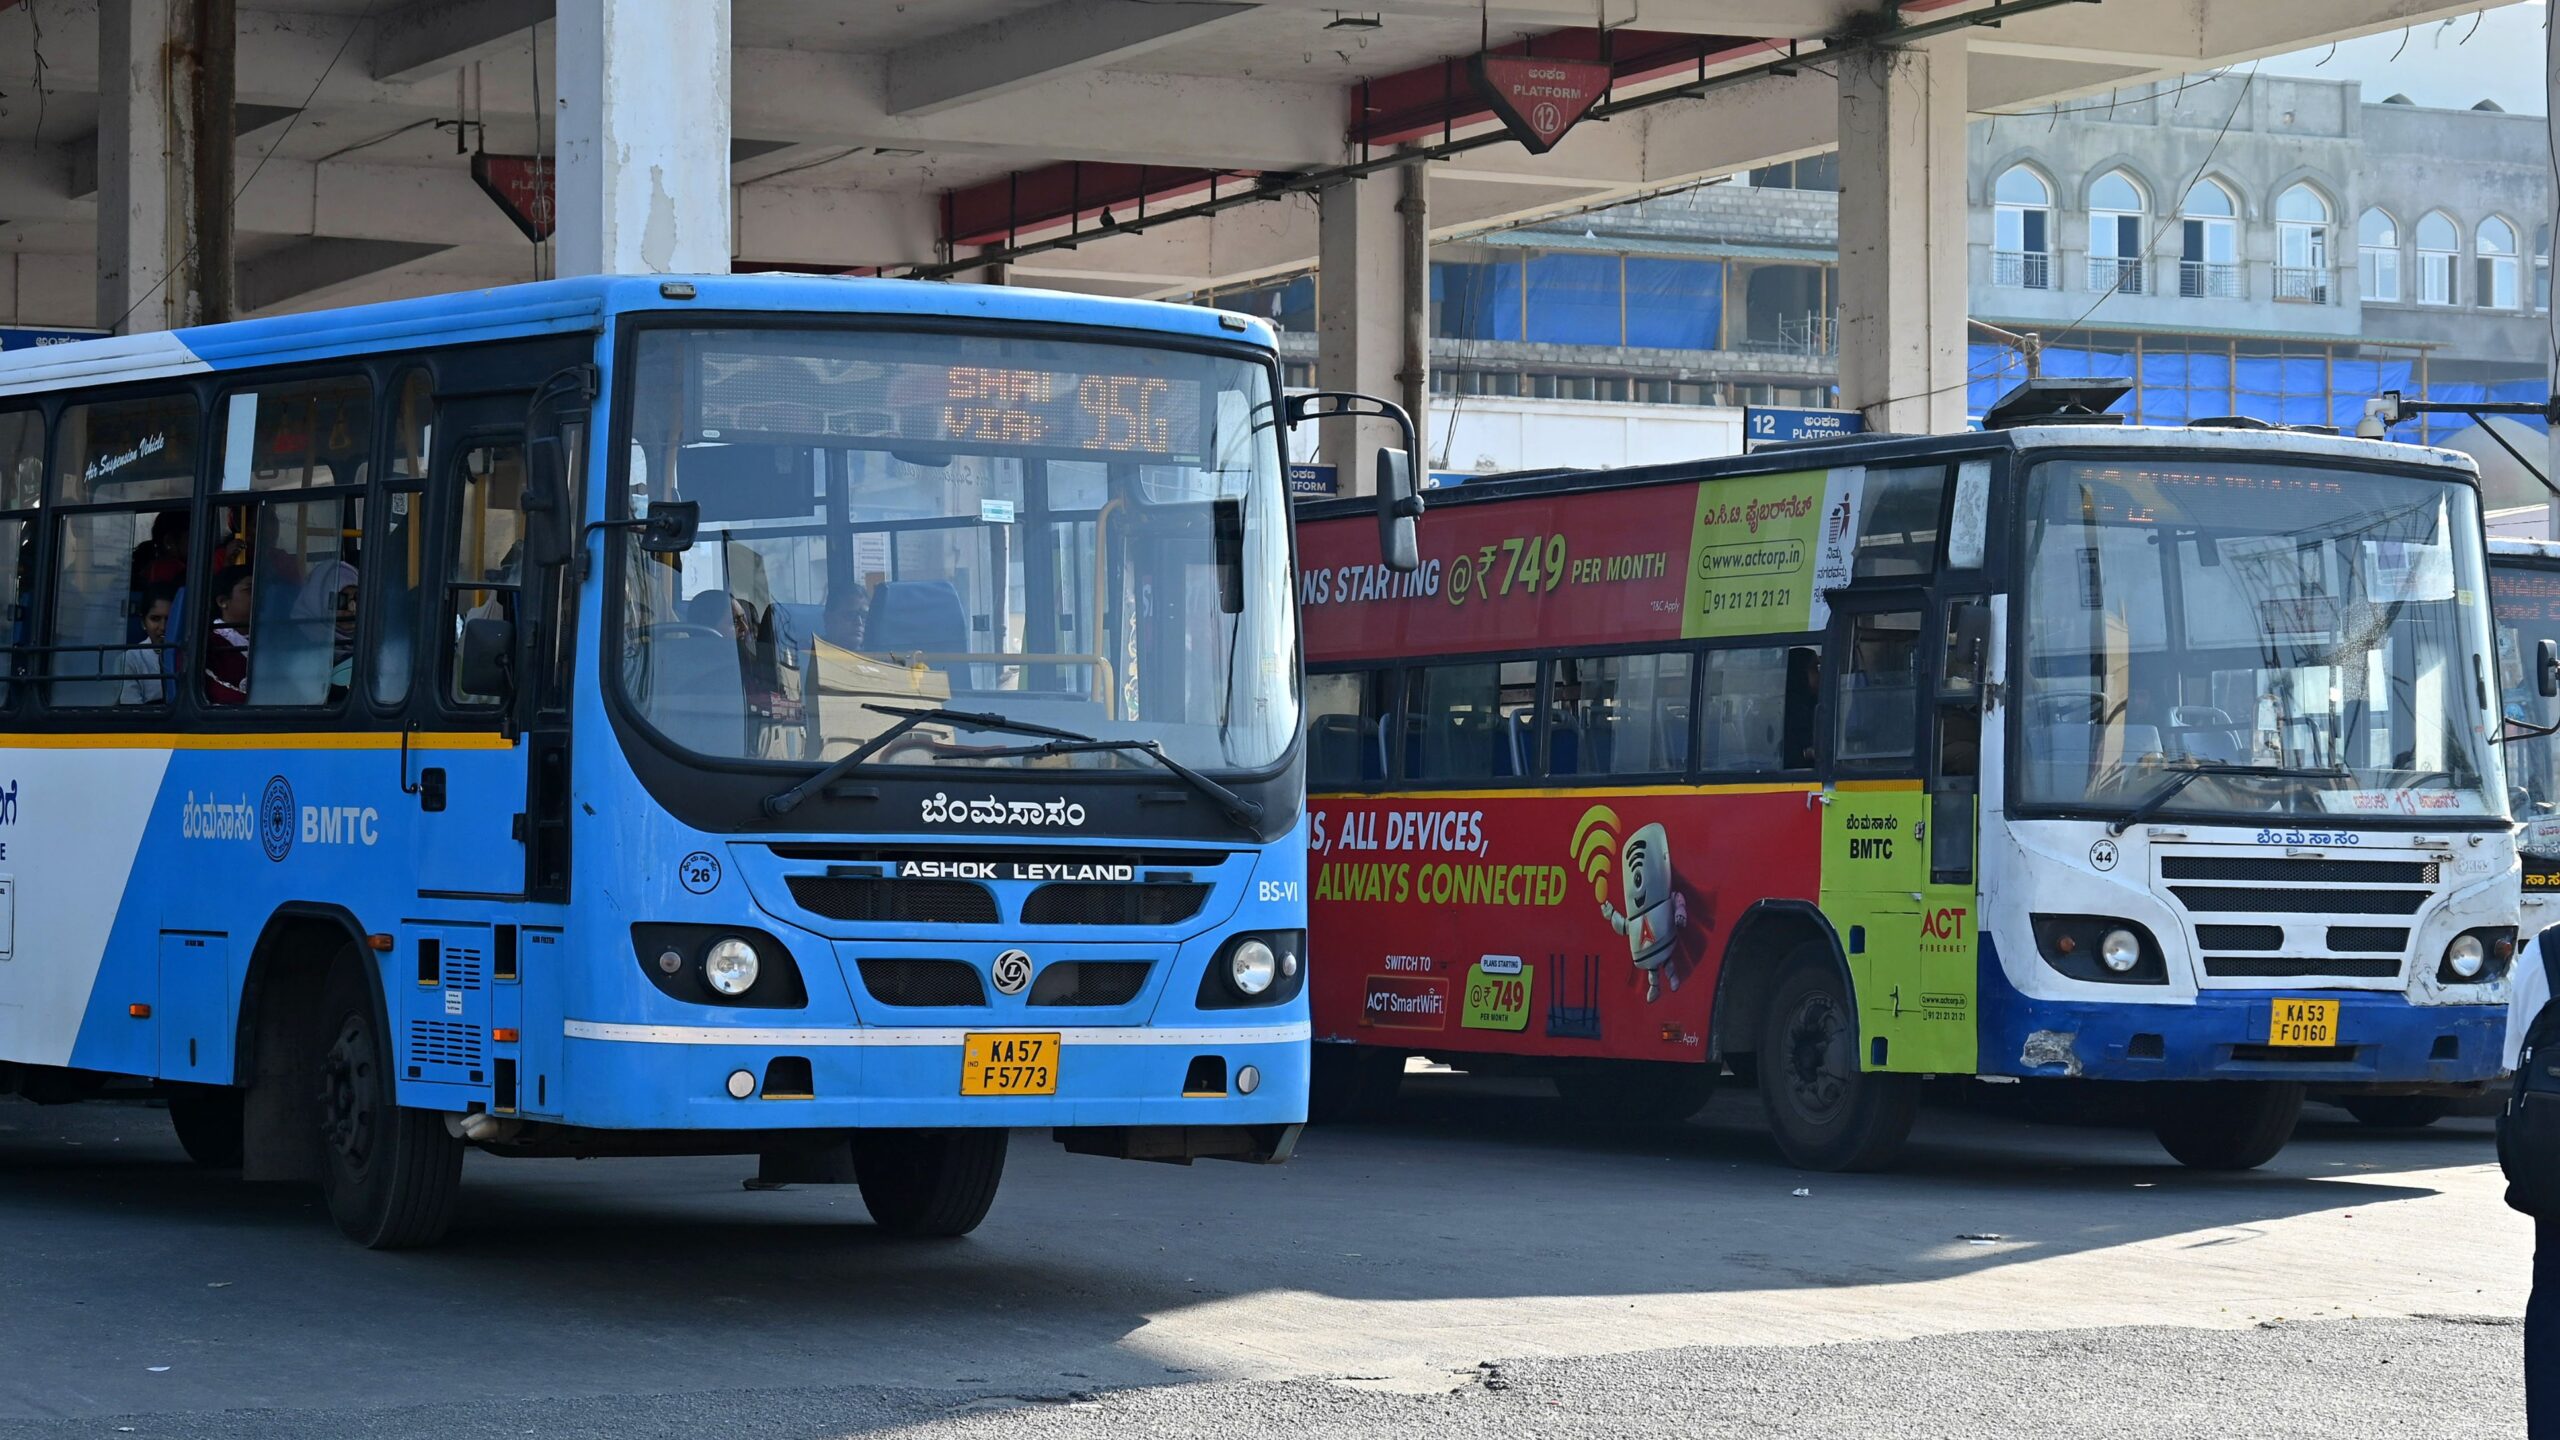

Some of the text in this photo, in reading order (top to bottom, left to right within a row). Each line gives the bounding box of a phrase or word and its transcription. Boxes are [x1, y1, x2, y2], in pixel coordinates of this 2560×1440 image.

[1528, 68, 1567, 80] ಅಂಕಣ
[1513, 84, 1581, 99] PLATFORM
[1538, 106, 1554, 130] 12
[1080, 374, 1168, 452] 95G
[1803, 415, 1840, 428] ಅಂಕಣ
[1752, 414, 1776, 434] 12
[99, 454, 138, 477] Suspension
[139, 431, 165, 458] Vehicle
[1712, 544, 1801, 570] www.actcorp.in
[1571, 557, 1602, 584] PER
[1606, 552, 1667, 582] MONTH
[1664, 597, 1681, 615] Apply
[1713, 588, 1791, 610] 91 21 21 21 21
[921, 792, 1087, 827] ಬೆಂಮಸಾಸಂ
[302, 805, 380, 847] BMTC
[1337, 811, 1379, 850] ALL
[1385, 810, 1490, 859] DEVICES,
[1849, 838, 1894, 860] BMTC
[2095, 851, 2113, 864] 44
[691, 868, 711, 883] 26
[902, 860, 1133, 881] ASHOK LEYLAND
[1259, 880, 1299, 902] BS-VI
[1314, 862, 1568, 906] ALWAYS CONNECTED
[1919, 907, 1967, 940] ACT
[1919, 943, 1968, 953] FIBERNET
[1384, 954, 1432, 972] SWITCH TO
[1483, 959, 1519, 970] PLANS STARTING
[1366, 991, 1390, 1010] ACT
[1926, 996, 1966, 1006] www.actcorp.in
[1480, 1012, 1509, 1022] PER MONTH
[1682, 1031, 1699, 1047] Apply
[967, 1060, 979, 1068] IND
